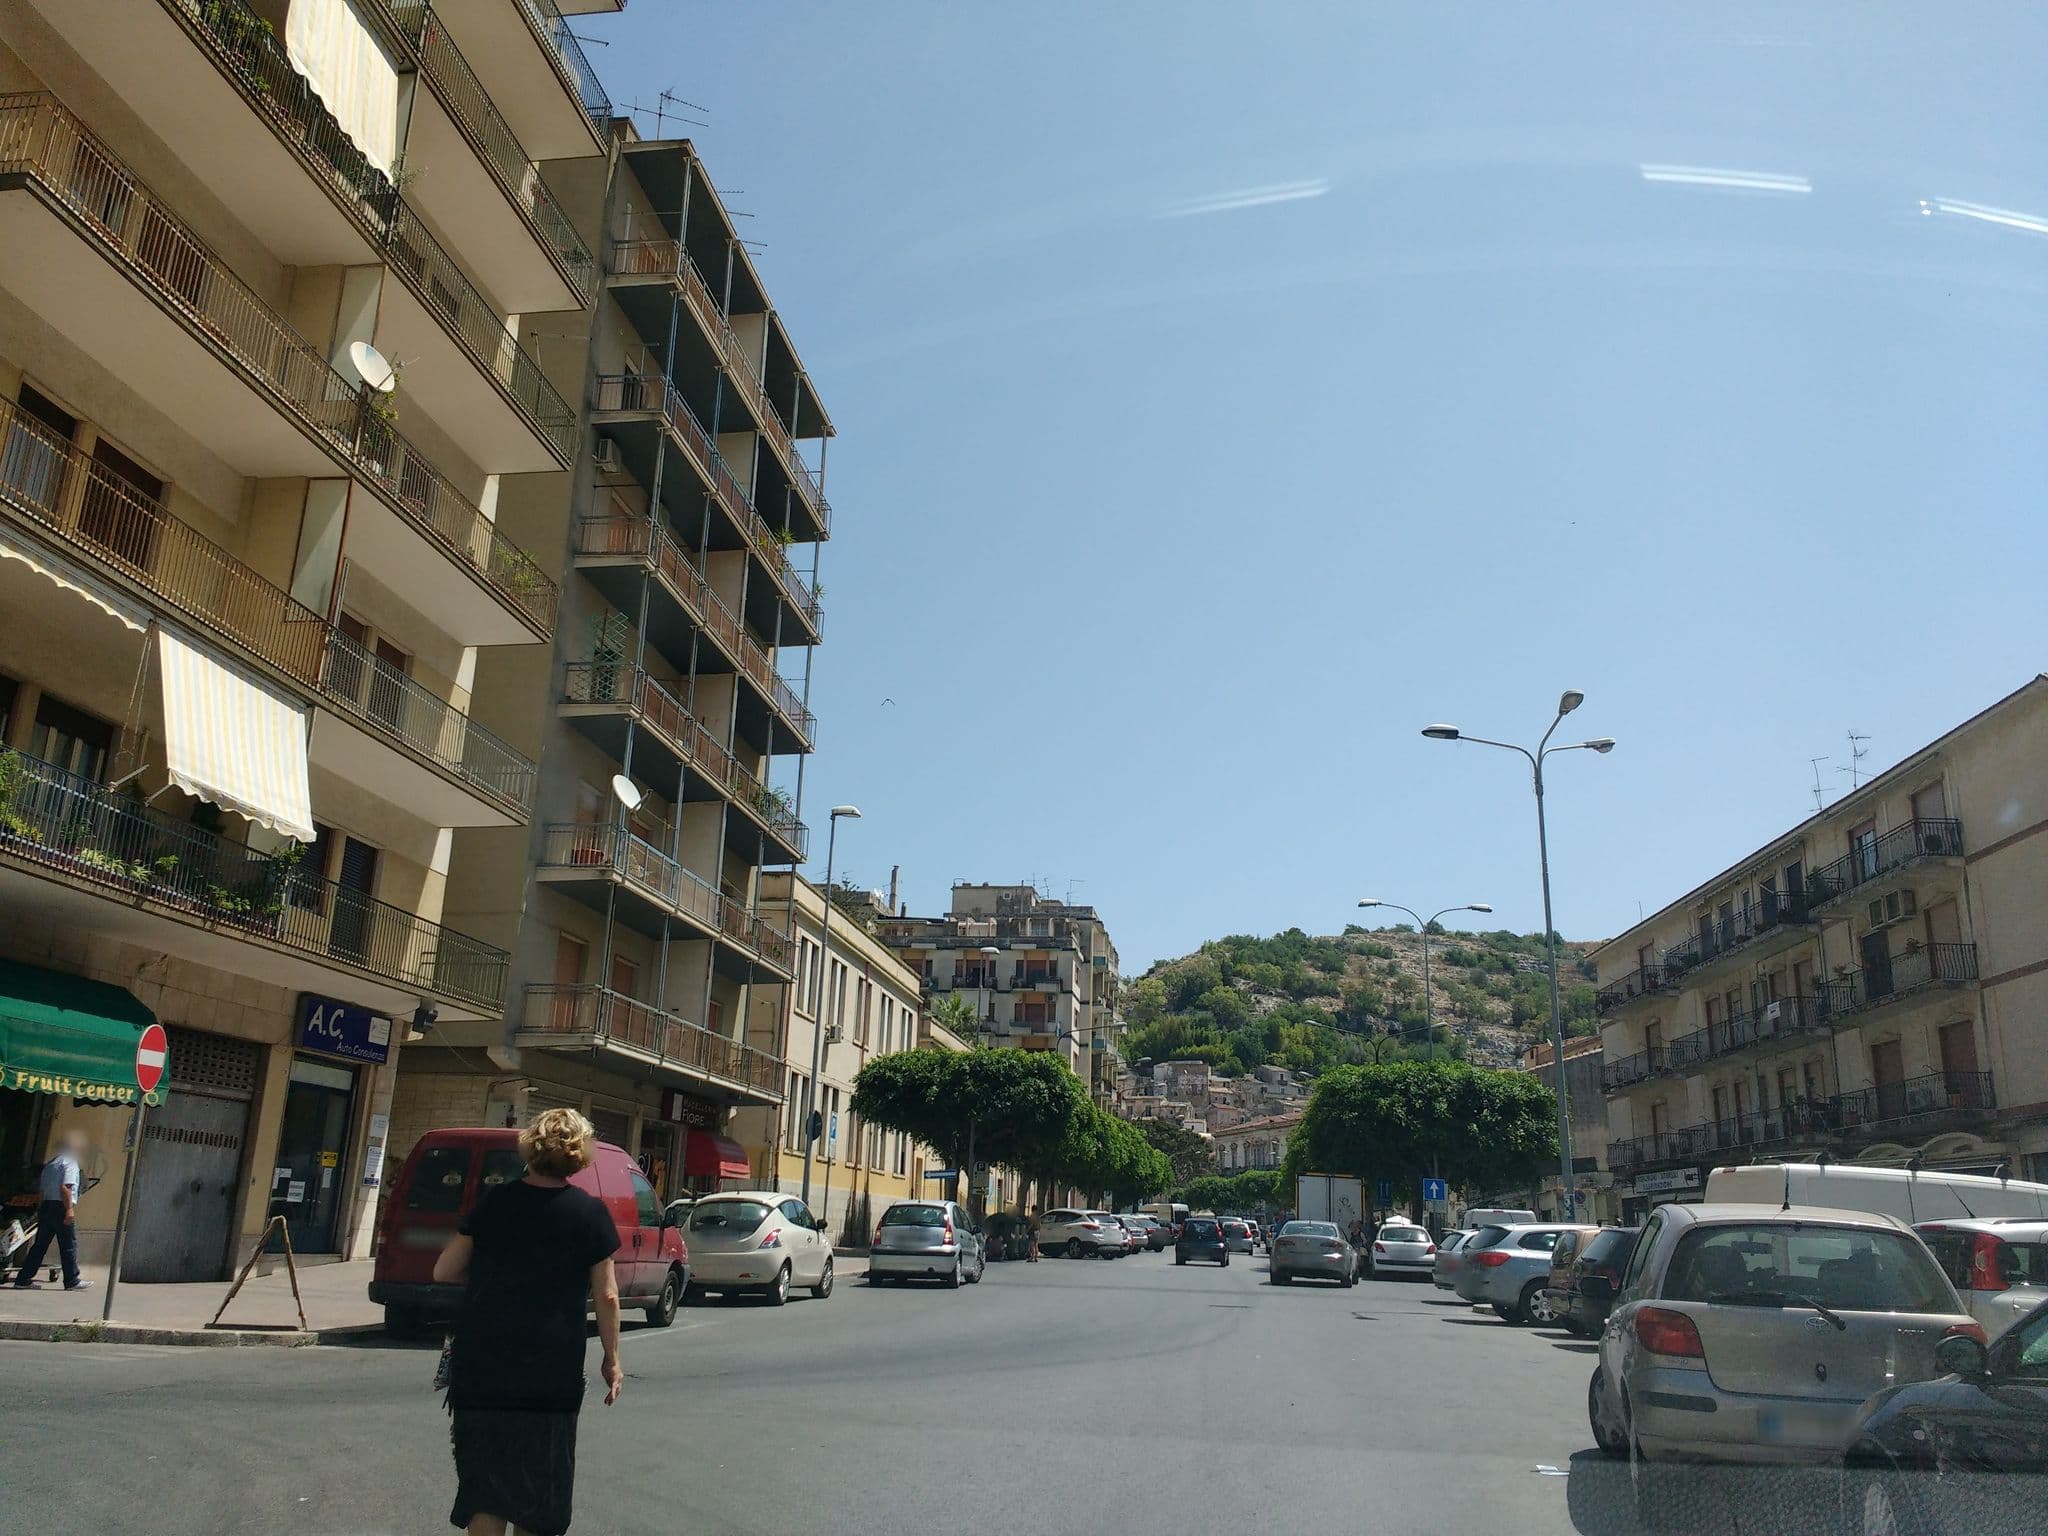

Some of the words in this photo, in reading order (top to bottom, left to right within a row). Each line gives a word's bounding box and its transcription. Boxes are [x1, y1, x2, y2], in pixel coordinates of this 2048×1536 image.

[308, 1004, 345, 1040] A.C.
[336, 1041, 352, 1054] Auto
[15, 1071, 72, 1094] Fruit
[76, 1080, 134, 1100] Center
[682, 1108, 705, 1127] FIORE
